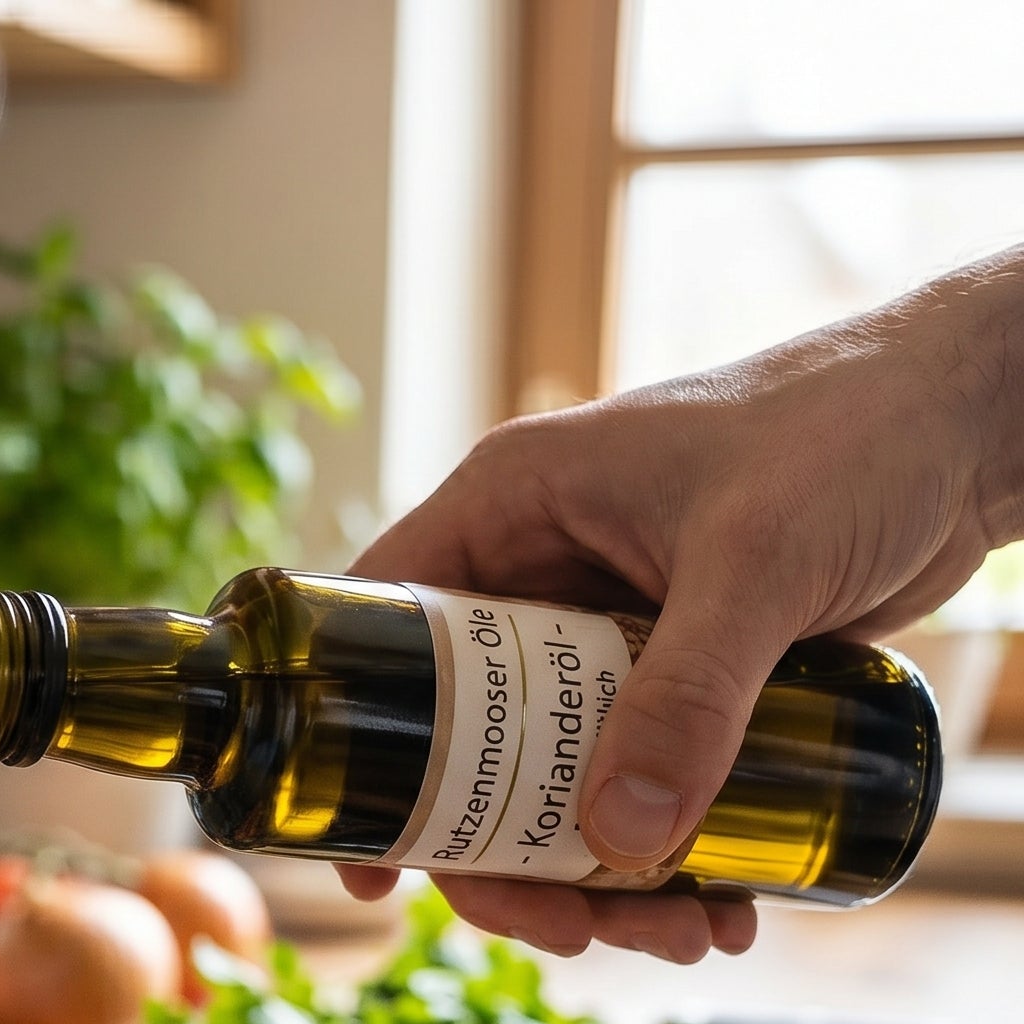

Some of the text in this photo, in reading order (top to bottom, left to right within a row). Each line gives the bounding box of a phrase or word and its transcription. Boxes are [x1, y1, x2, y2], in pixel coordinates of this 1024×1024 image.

[432, 608, 508, 861] Rutzenmooser Öle
[517, 640, 583, 848] Korianderöl
